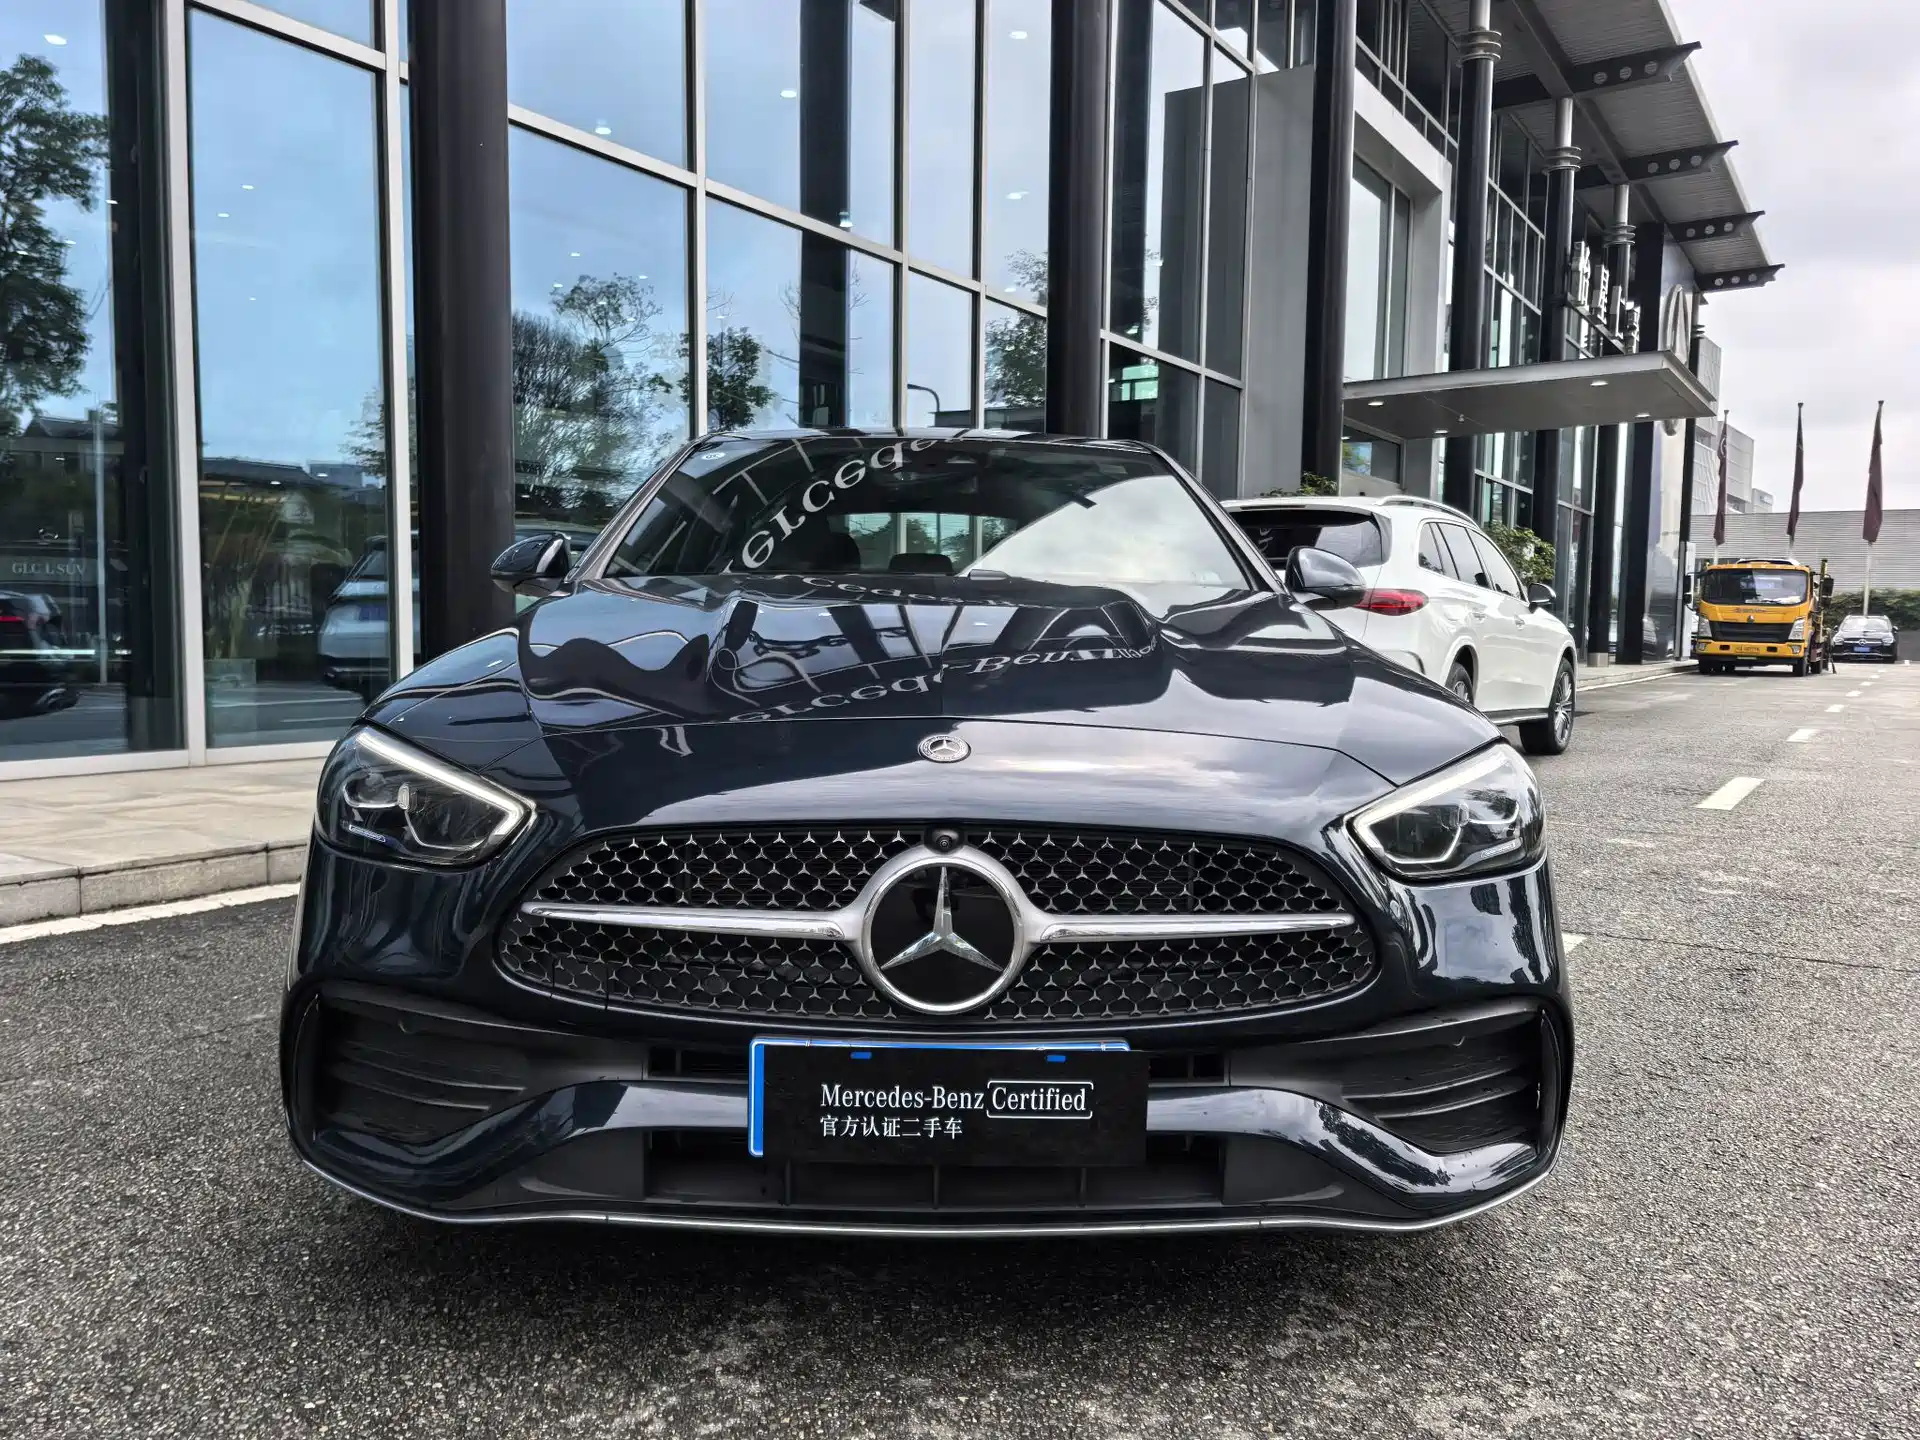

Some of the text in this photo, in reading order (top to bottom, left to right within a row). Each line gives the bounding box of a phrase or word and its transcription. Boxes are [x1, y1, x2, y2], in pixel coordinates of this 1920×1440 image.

[820, 1083, 1087, 1112] Mercedes-Benz Certified
[819, 1114, 964, 1140] 官方认证二手车
